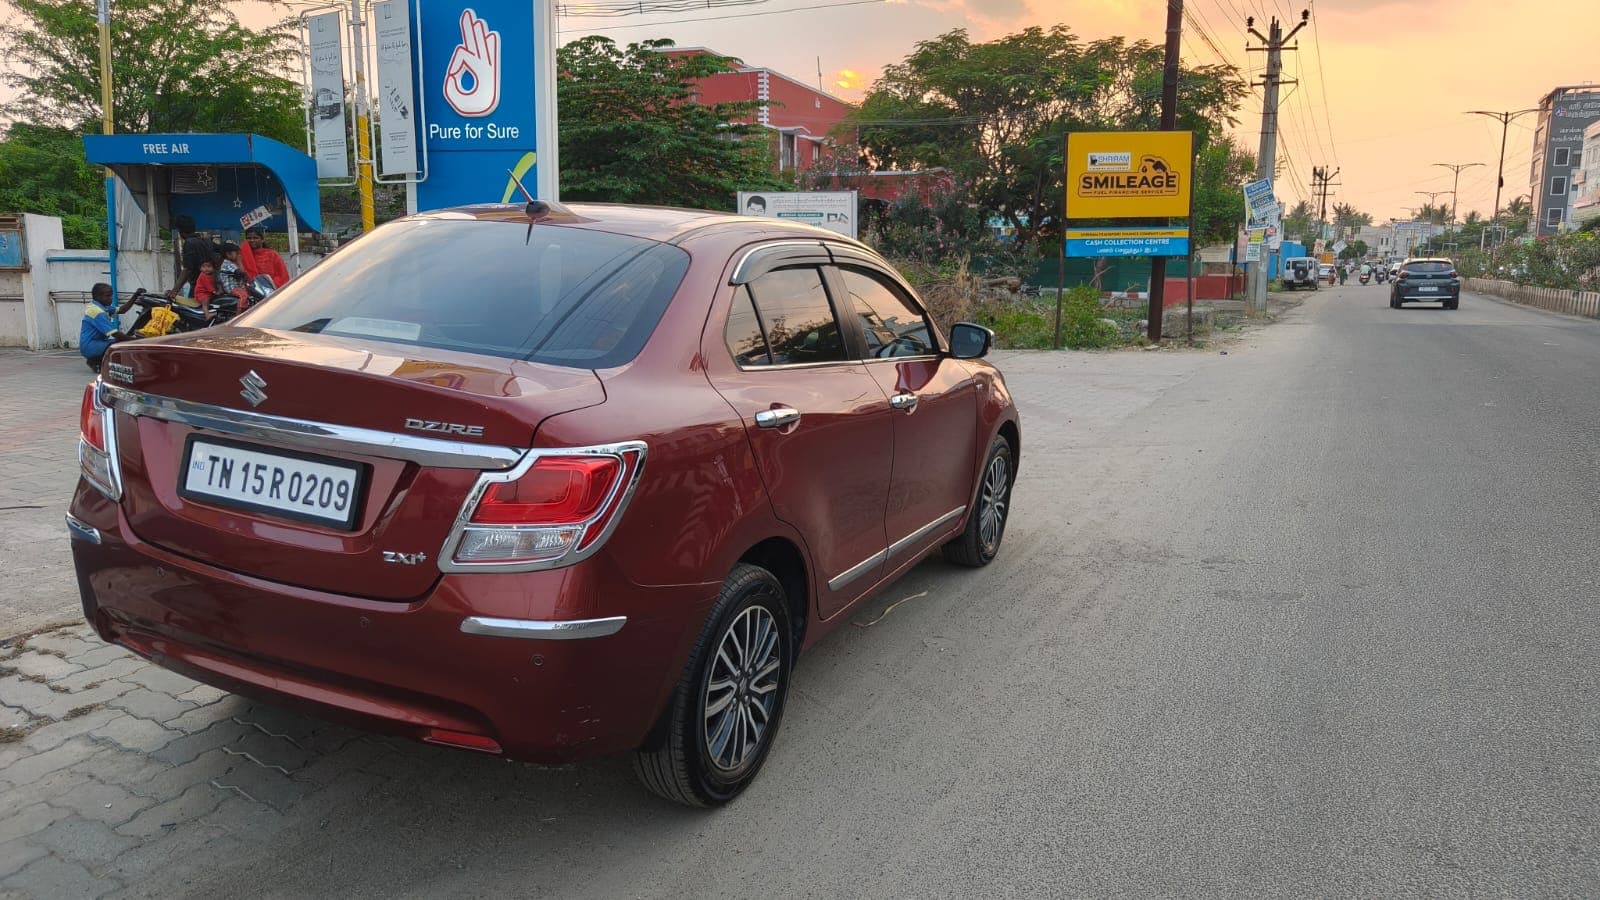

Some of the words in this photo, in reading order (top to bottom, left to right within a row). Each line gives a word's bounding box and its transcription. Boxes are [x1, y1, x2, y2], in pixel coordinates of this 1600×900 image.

[430, 124, 461, 139] Pure
[465, 123, 483, 139] for
[487, 123, 519, 139] Sure
[143, 143, 168, 154] FREE
[171, 143, 190, 154] AIR
[1082, 175, 1177, 189] SMILEAGE
[404, 418, 485, 436] DZIRE
[207, 455, 234, 489] TN
